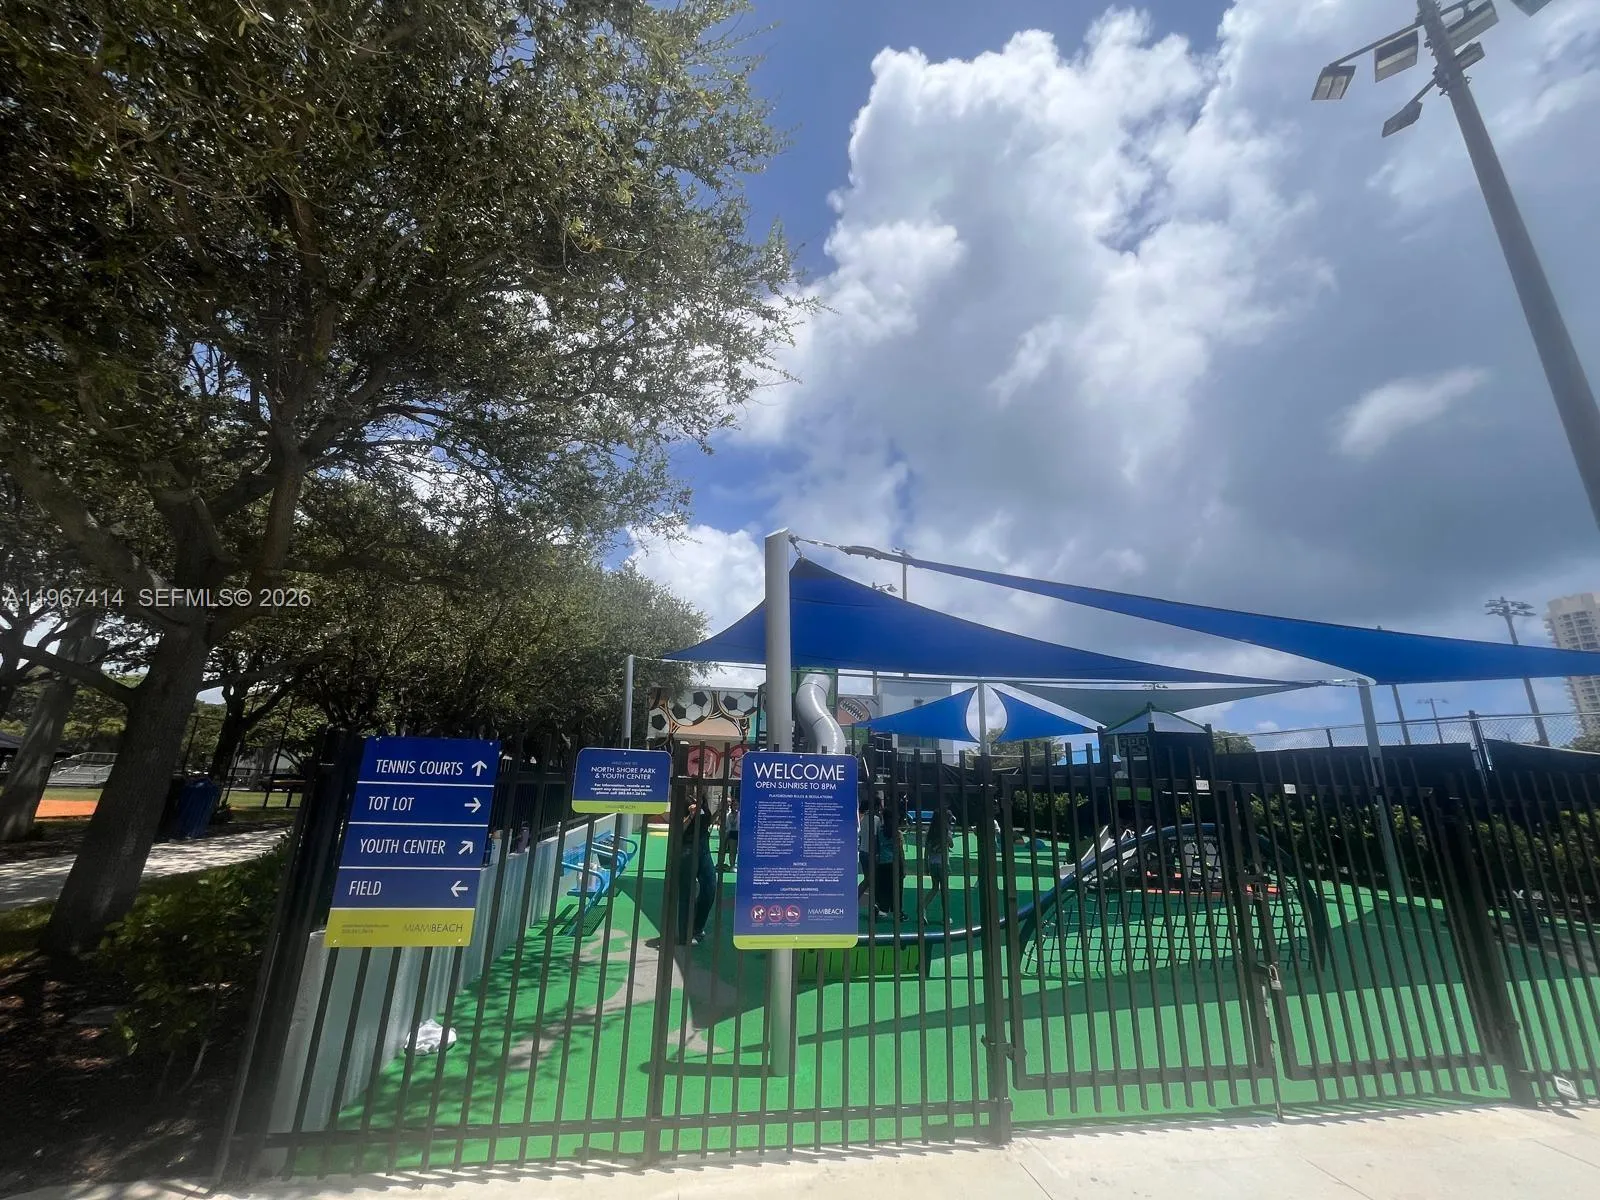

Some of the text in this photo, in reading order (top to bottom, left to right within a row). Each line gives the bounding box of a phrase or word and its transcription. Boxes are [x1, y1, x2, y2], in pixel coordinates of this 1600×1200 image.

[376, 759, 464, 776] TENNIS COURTS
[753, 762, 845, 781] WELCOME
[755, 781, 776, 789] OPEN
[778, 782, 808, 790] SUNRISE
[810, 782, 819, 790] TO
[368, 796, 414, 811] TOT LOT
[360, 838, 446, 855] YOUTH CENTER
[348, 880, 382, 896] FIELD
